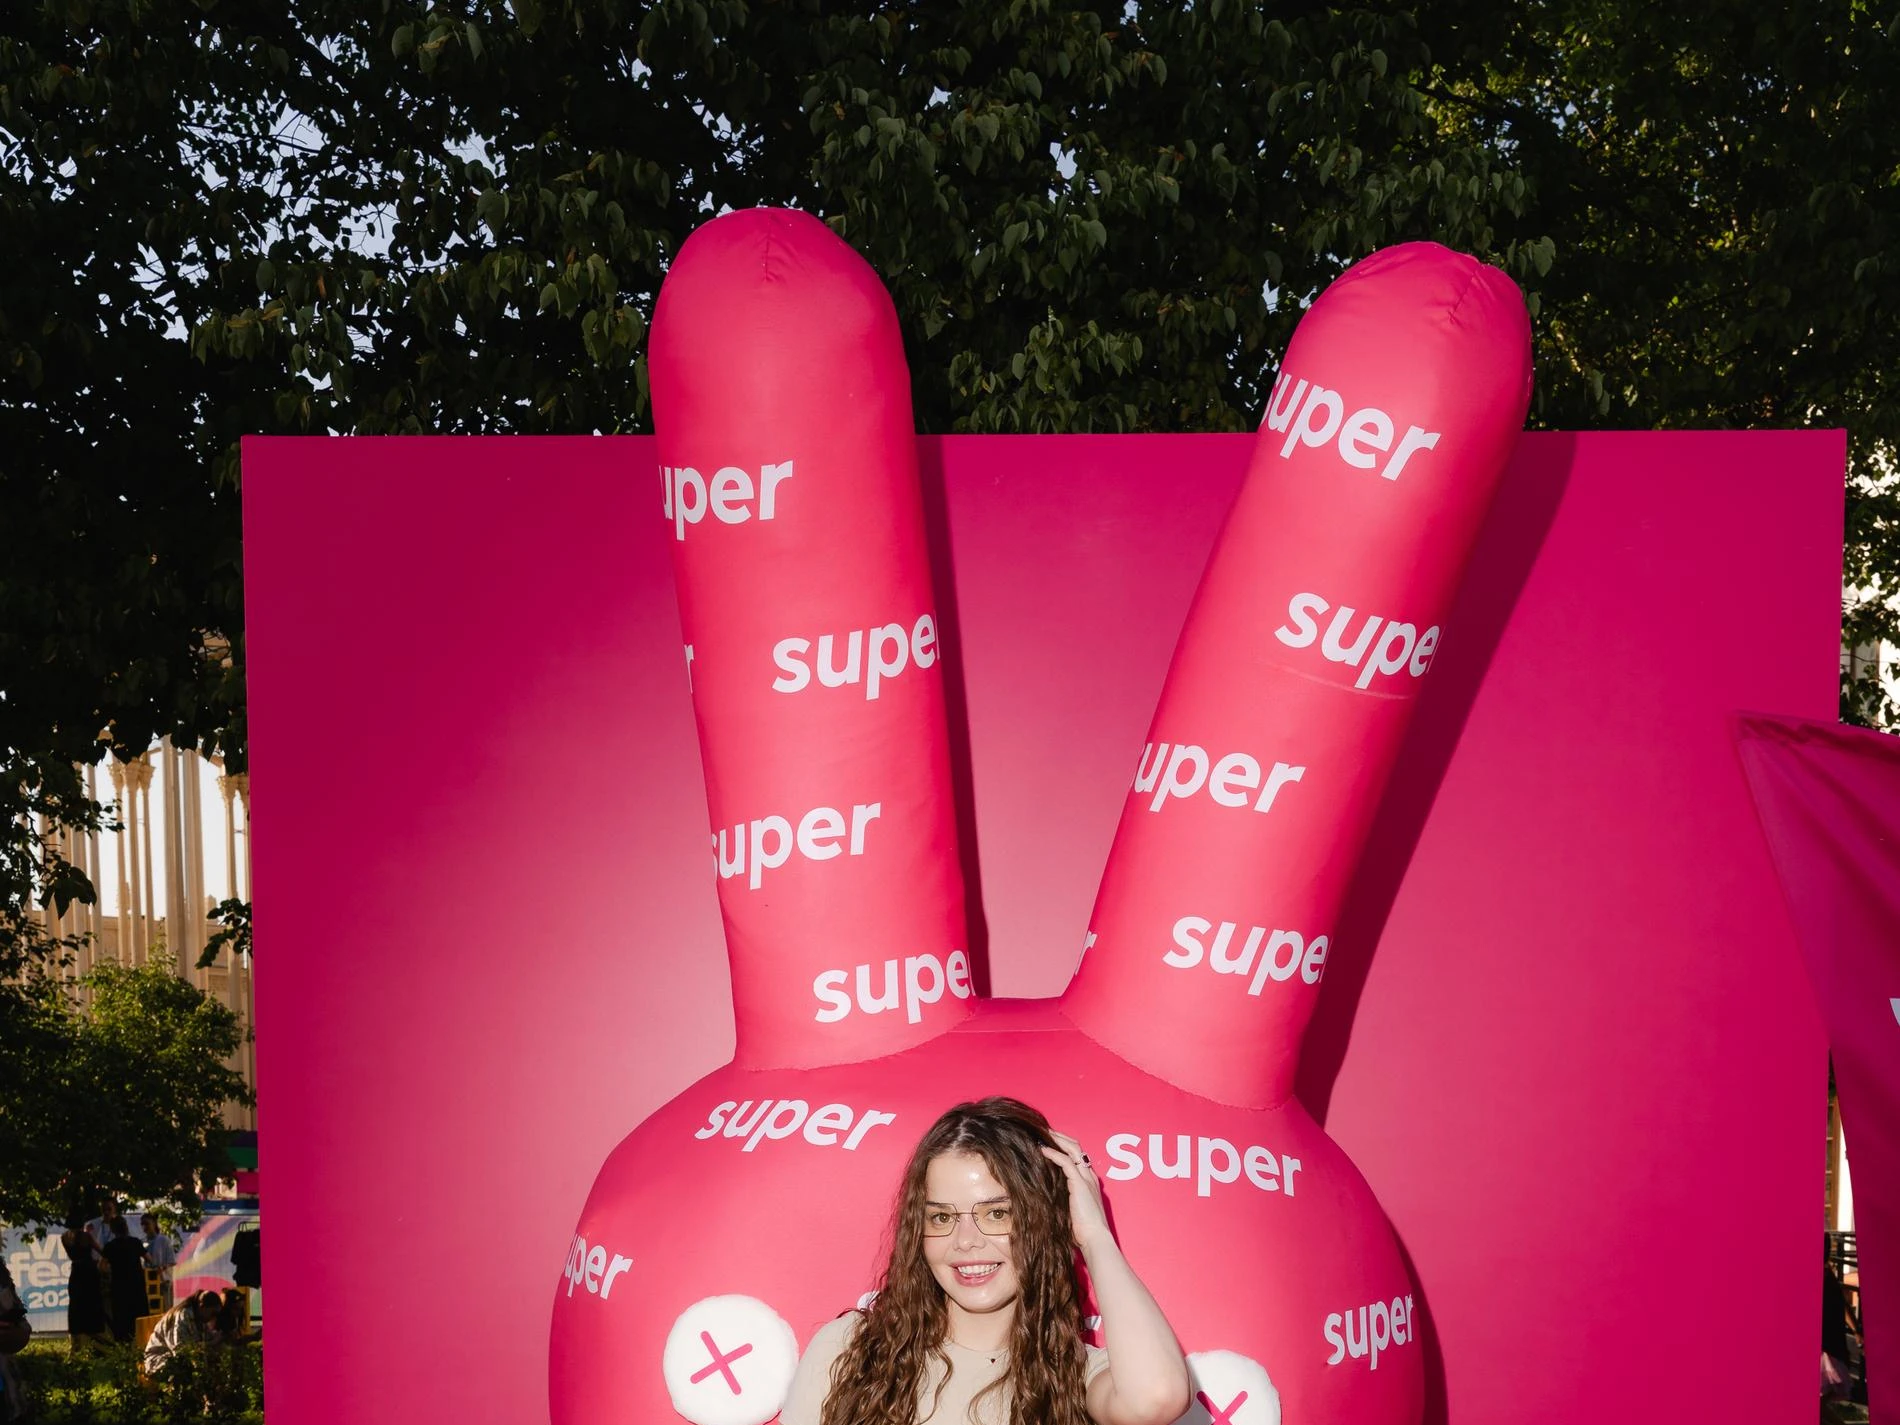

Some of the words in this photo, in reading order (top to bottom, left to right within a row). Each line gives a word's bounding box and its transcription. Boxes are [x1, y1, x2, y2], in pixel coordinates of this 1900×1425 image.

[659, 459, 793, 540] uper
[772, 611, 940, 701] supe
[1274, 591, 1444, 689] supe
[1133, 740, 1306, 814] uper
[813, 947, 977, 1024] supe
[1162, 913, 1329, 996] supe
[694, 1097, 896, 1153] super
[1104, 1131, 1302, 1198] super
[28, 1289, 70, 1309] 202
[563, 1233, 634, 1300] uper
[1323, 1293, 1413, 1370] super
